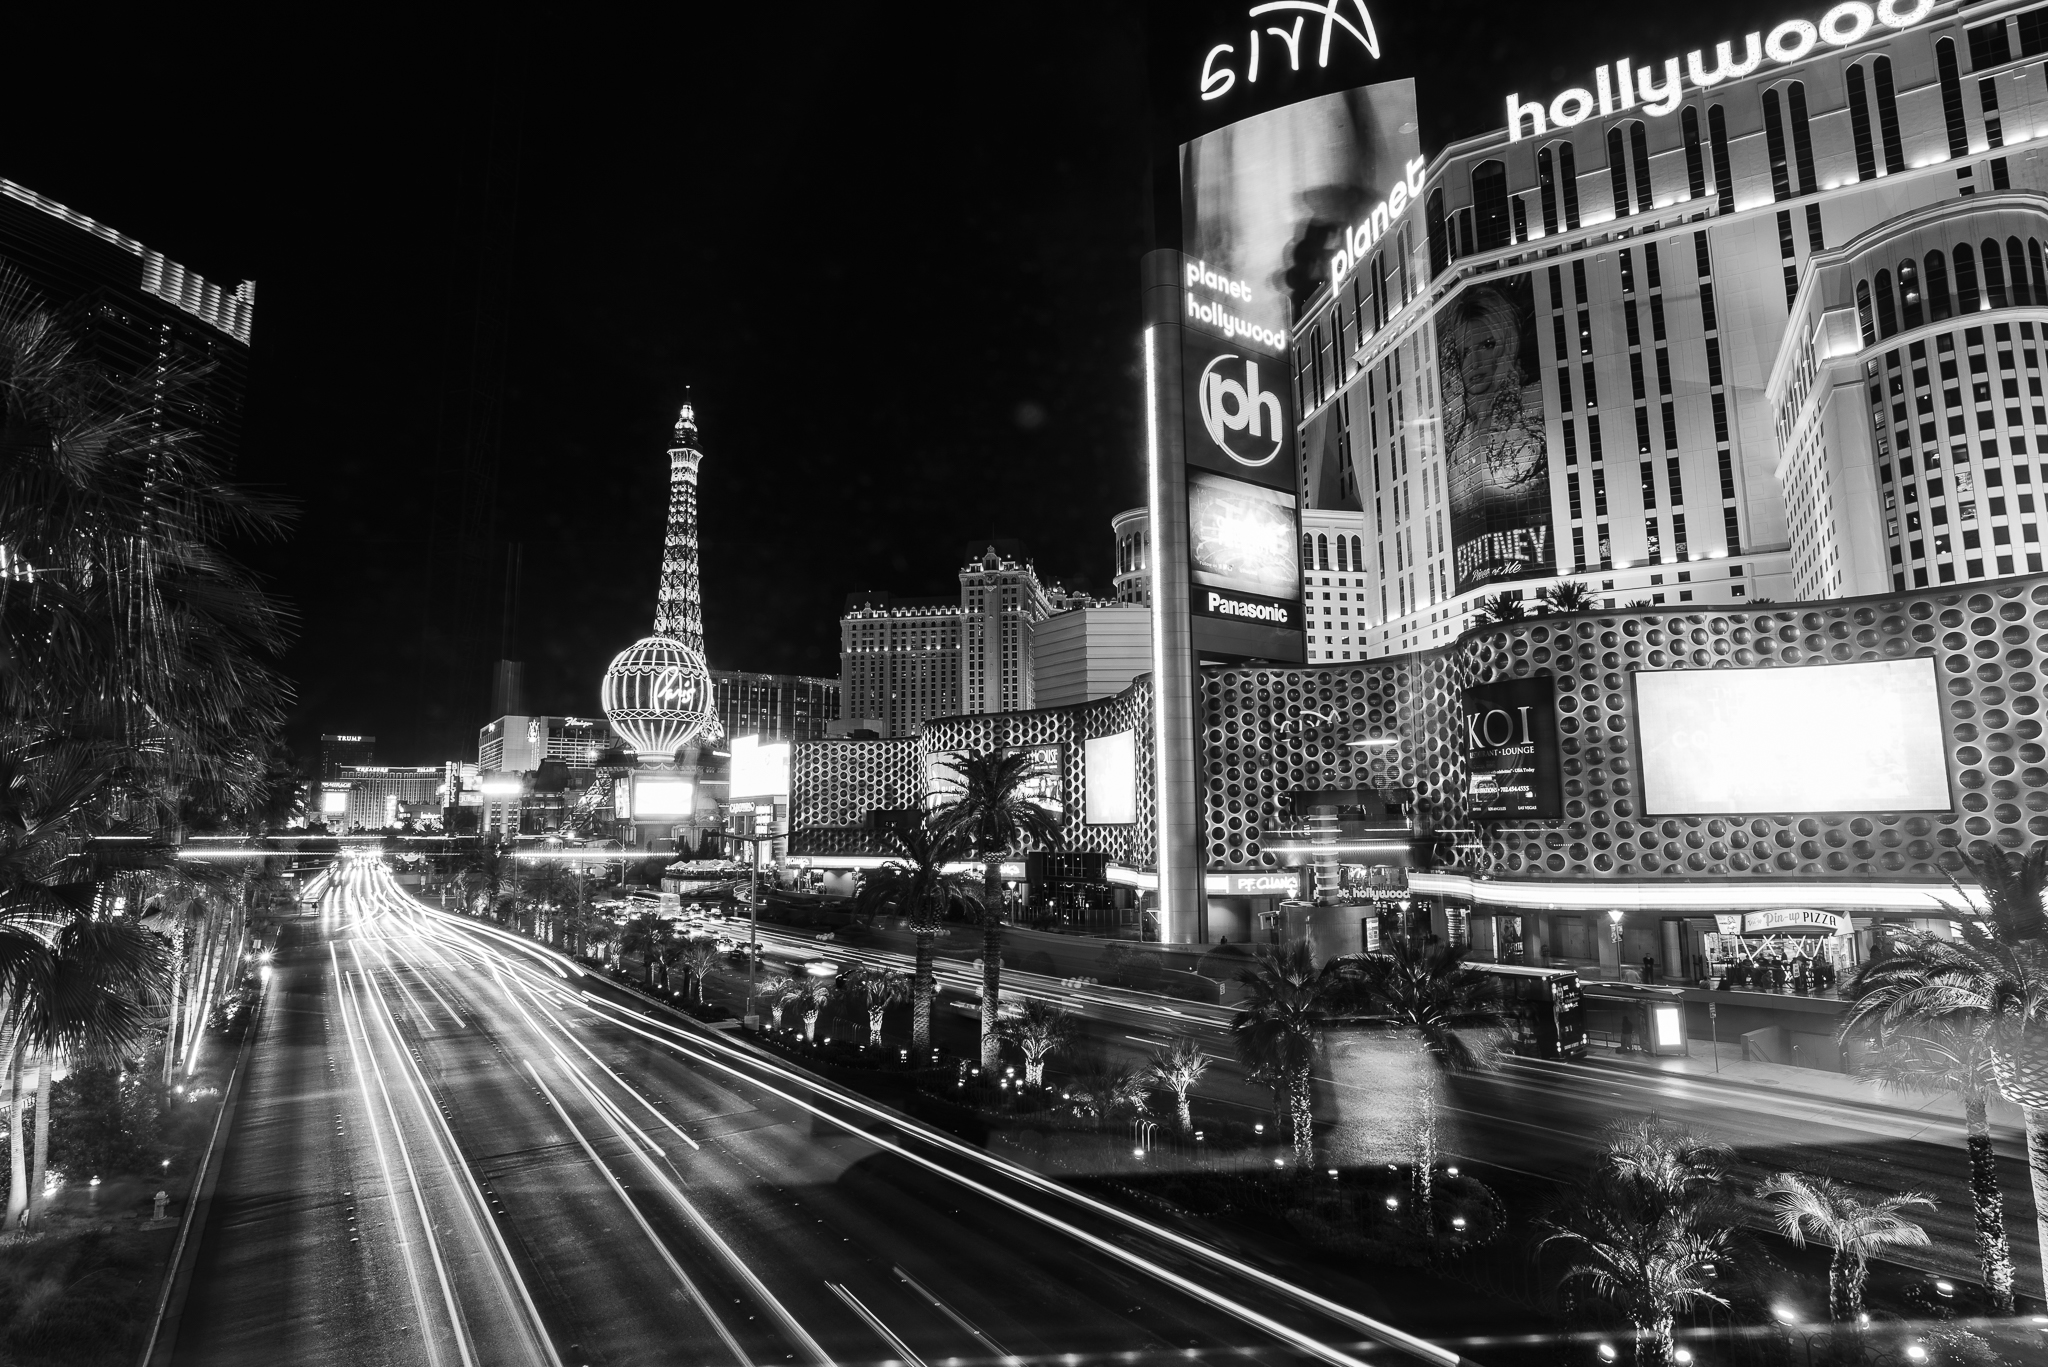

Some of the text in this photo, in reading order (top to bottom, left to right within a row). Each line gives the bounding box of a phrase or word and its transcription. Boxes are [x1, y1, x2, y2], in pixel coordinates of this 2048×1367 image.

[1331, 154, 1426, 298] planet
[1186, 260, 1253, 303] planet
[1187, 293, 1287, 351] hollywood
[1457, 524, 1547, 584] BRITNEY
[1501, 560, 1522, 576] Me
[1207, 591, 1289, 624] Panasonic
[655, 665, 696, 714] Paris
[1466, 706, 1534, 750] KOI
[1502, 745, 1535, 756] LOUNGE
[1353, 886, 1411, 901] hollywood
[1802, 911, 1837, 927] PIZZA
